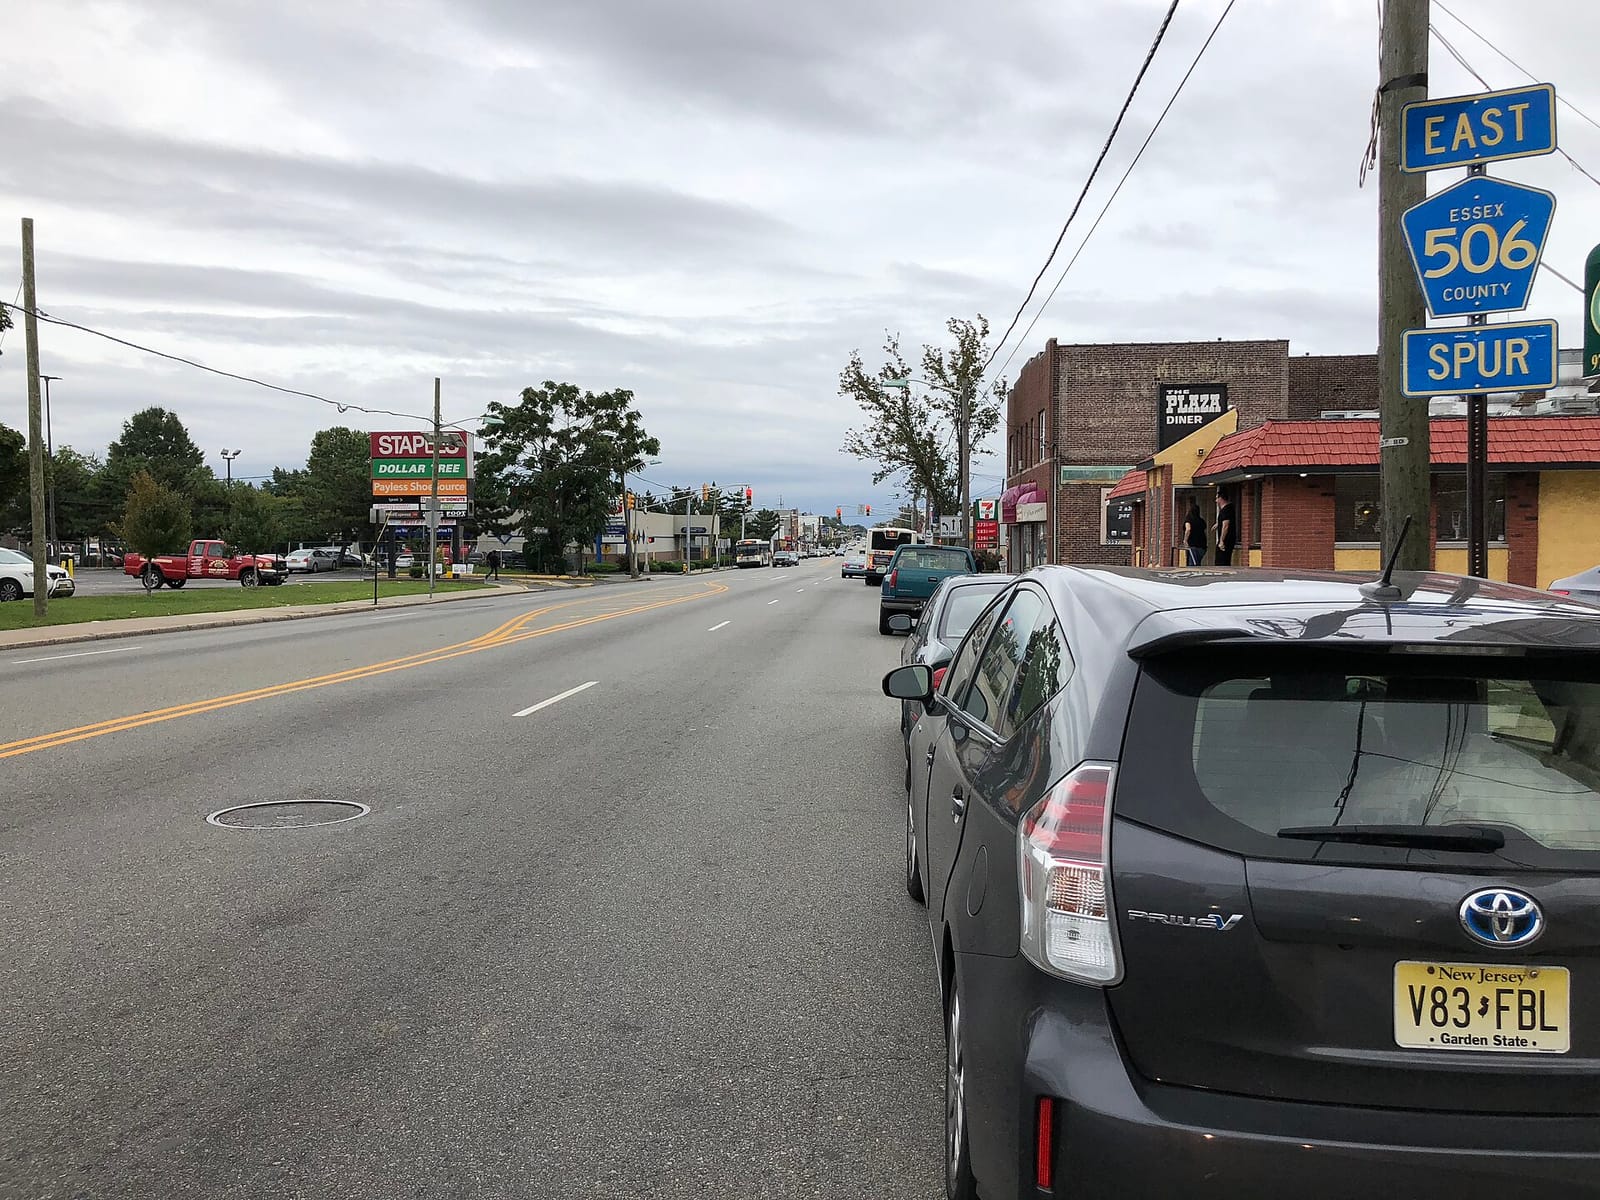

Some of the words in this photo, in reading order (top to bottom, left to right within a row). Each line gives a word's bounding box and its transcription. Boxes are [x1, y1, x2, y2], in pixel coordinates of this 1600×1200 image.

[1424, 102, 1530, 155] EAST
[1449, 203, 1504, 222] ESSEX
[1424, 219, 1537, 279] 506
[1442, 282, 1512, 302] COUNTY
[1427, 337, 1530, 381] SPUR
[1166, 393, 1221, 414] PLAZA
[1166, 415, 1203, 425] DINER
[378, 435, 460, 455] STAPLS
[378, 464, 426, 473] DOLLAR
[430, 464, 461, 473] REE
[374, 482, 409, 493] Payless
[410, 482, 465, 491] Shoeource
[1439, 967, 1475, 982] New
[1477, 967, 1526, 985] Jersey
[1440, 1033, 1488, 1046] Garden
[1492, 1034, 1528, 1047] State
